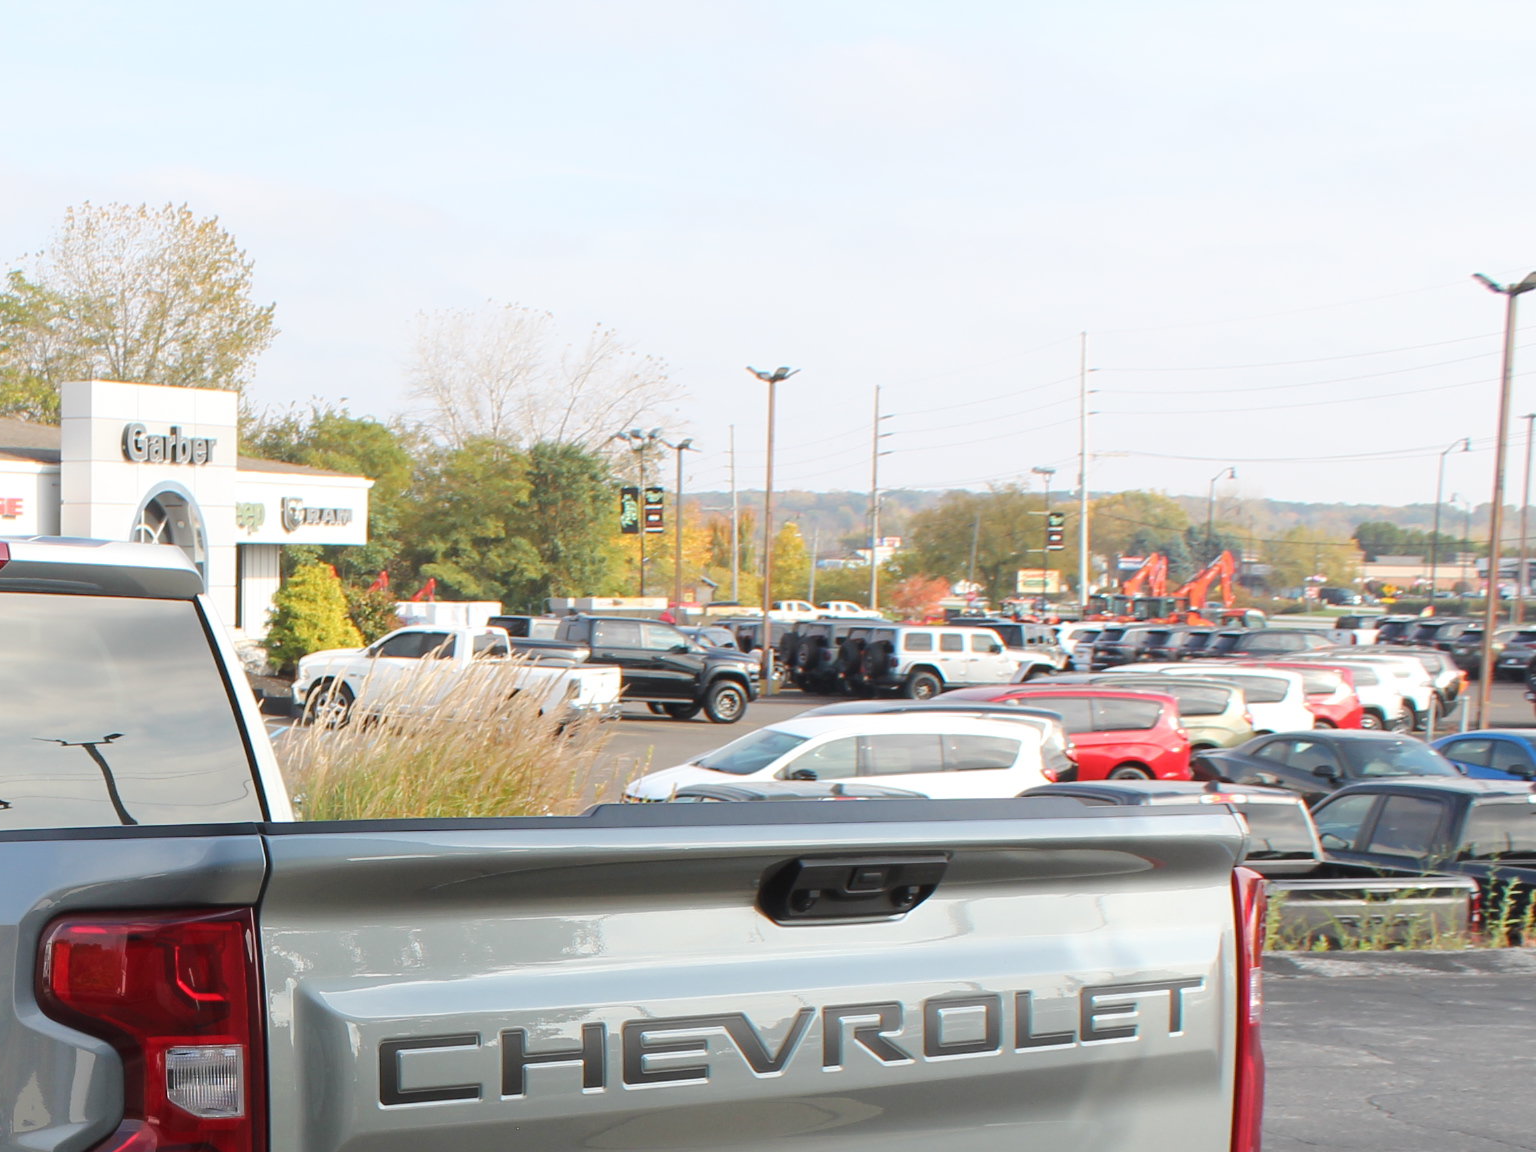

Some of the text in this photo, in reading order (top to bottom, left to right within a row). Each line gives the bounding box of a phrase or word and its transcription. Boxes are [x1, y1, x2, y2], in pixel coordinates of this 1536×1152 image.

[122, 423, 217, 464] Garber
[304, 507, 353, 526] RAM
[378, 977, 1205, 1110] CHEVROLET
